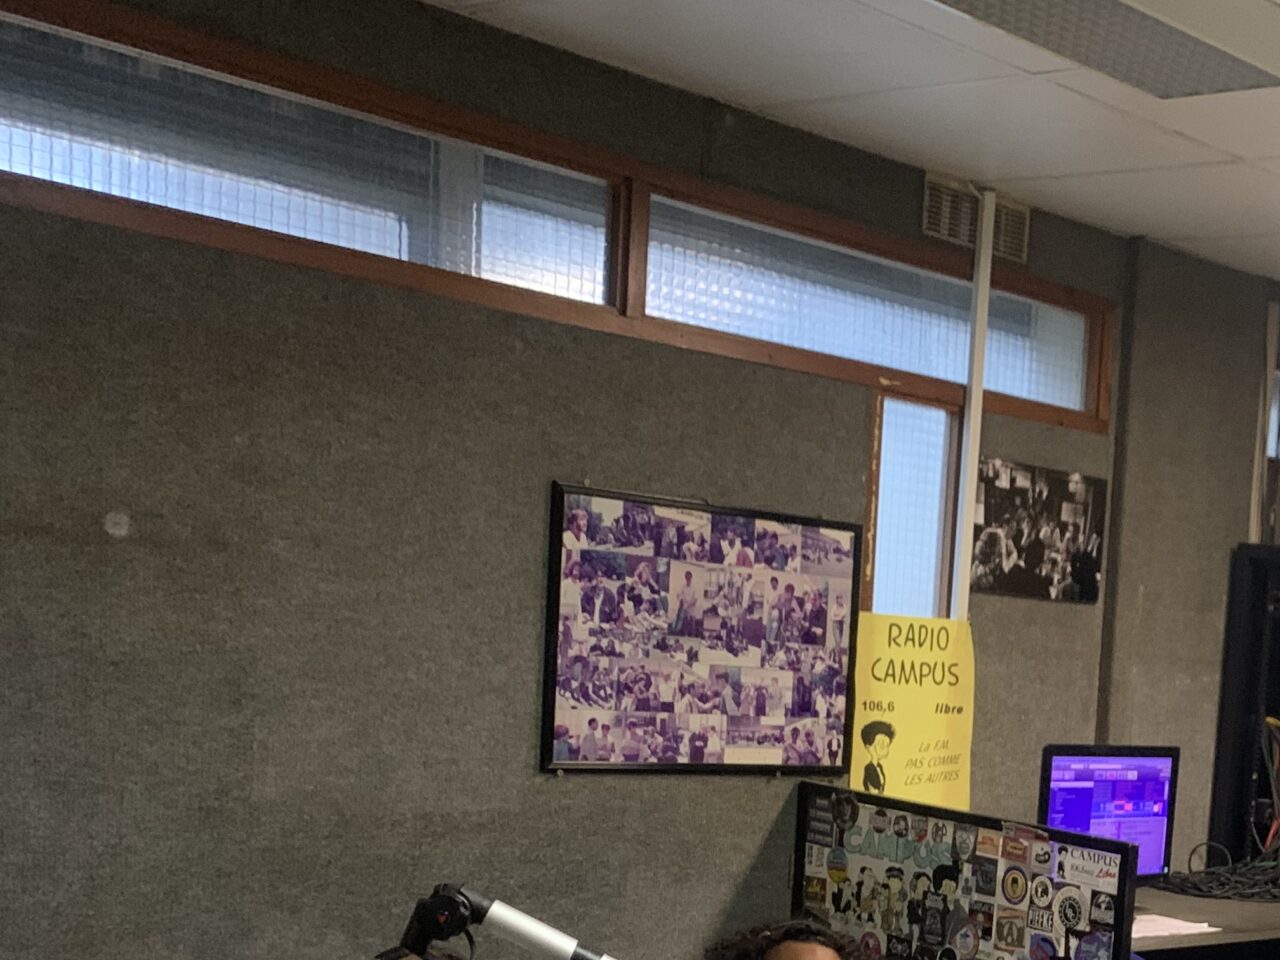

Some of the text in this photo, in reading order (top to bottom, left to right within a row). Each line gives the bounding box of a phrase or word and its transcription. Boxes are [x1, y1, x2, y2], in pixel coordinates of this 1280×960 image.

[888, 622, 950, 652] RADIO
[871, 657, 960, 687] CAMPUS
[935, 703, 964, 715] libre
[904, 752, 962, 769] PAS COMME
[904, 773, 924, 786] LES
[1070, 846, 1118, 868] CAMPUS
